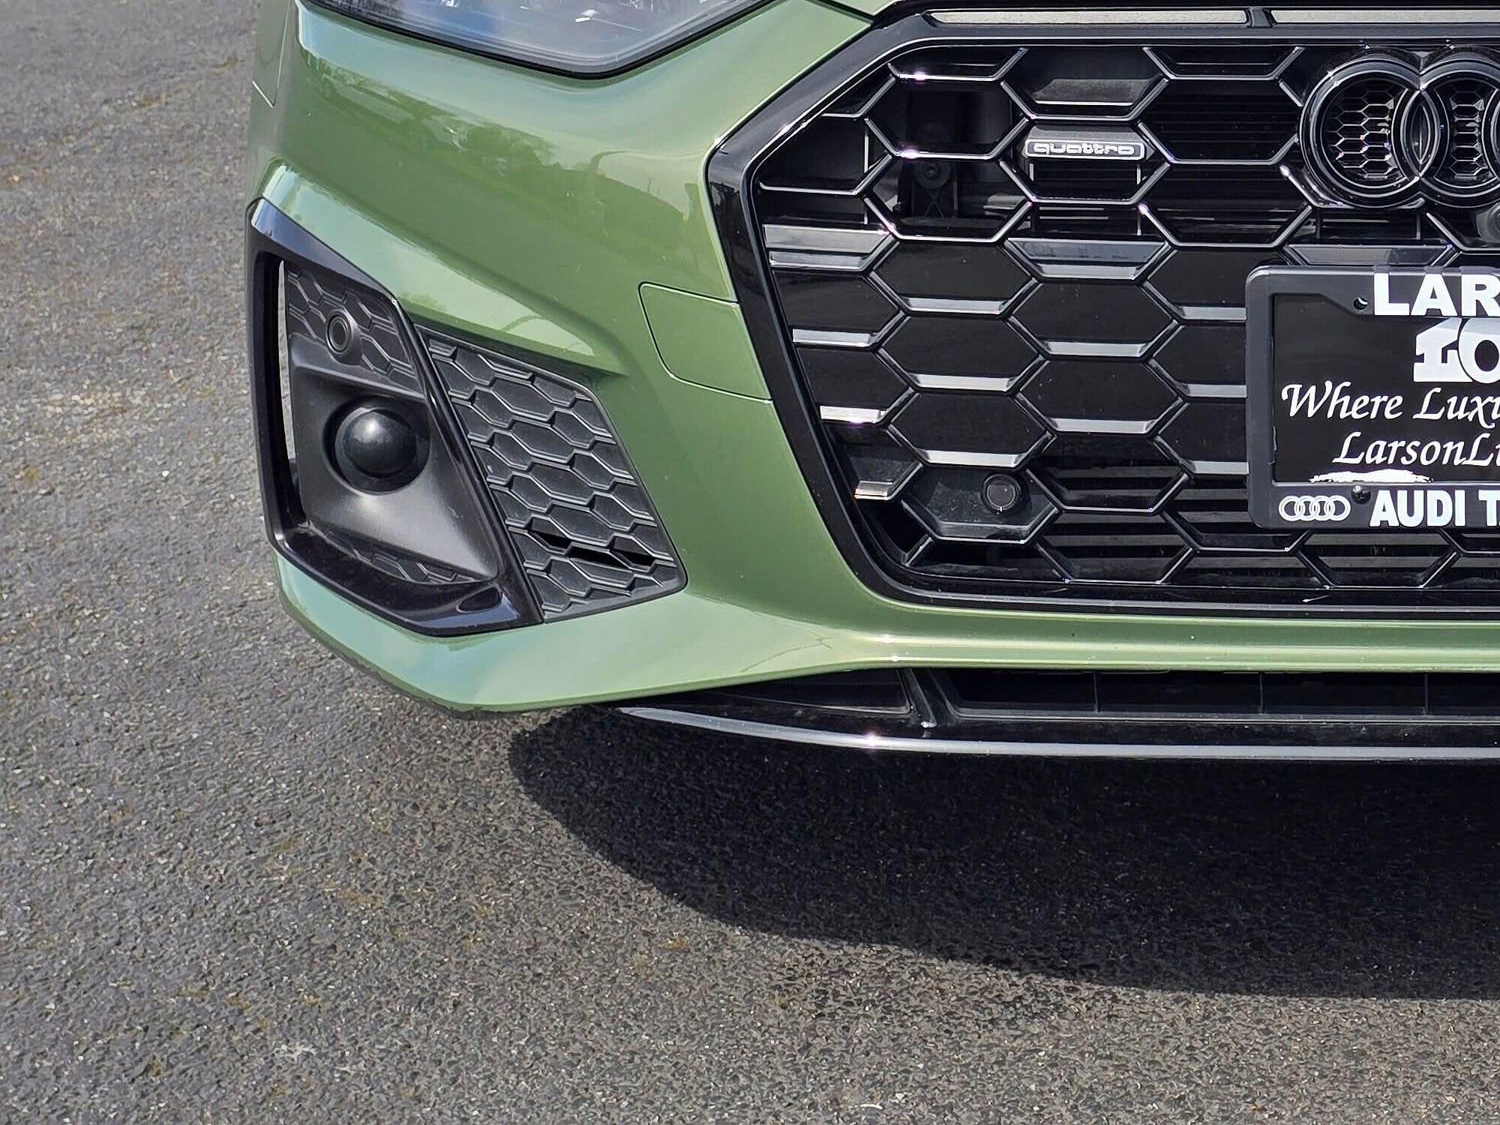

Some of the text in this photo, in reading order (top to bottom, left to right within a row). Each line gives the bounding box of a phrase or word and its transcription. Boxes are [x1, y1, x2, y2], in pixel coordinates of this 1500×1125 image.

[1033, 142, 1135, 156] quattro
[1281, 380, 1404, 419] Where
[1369, 489, 1466, 528] AUDI
